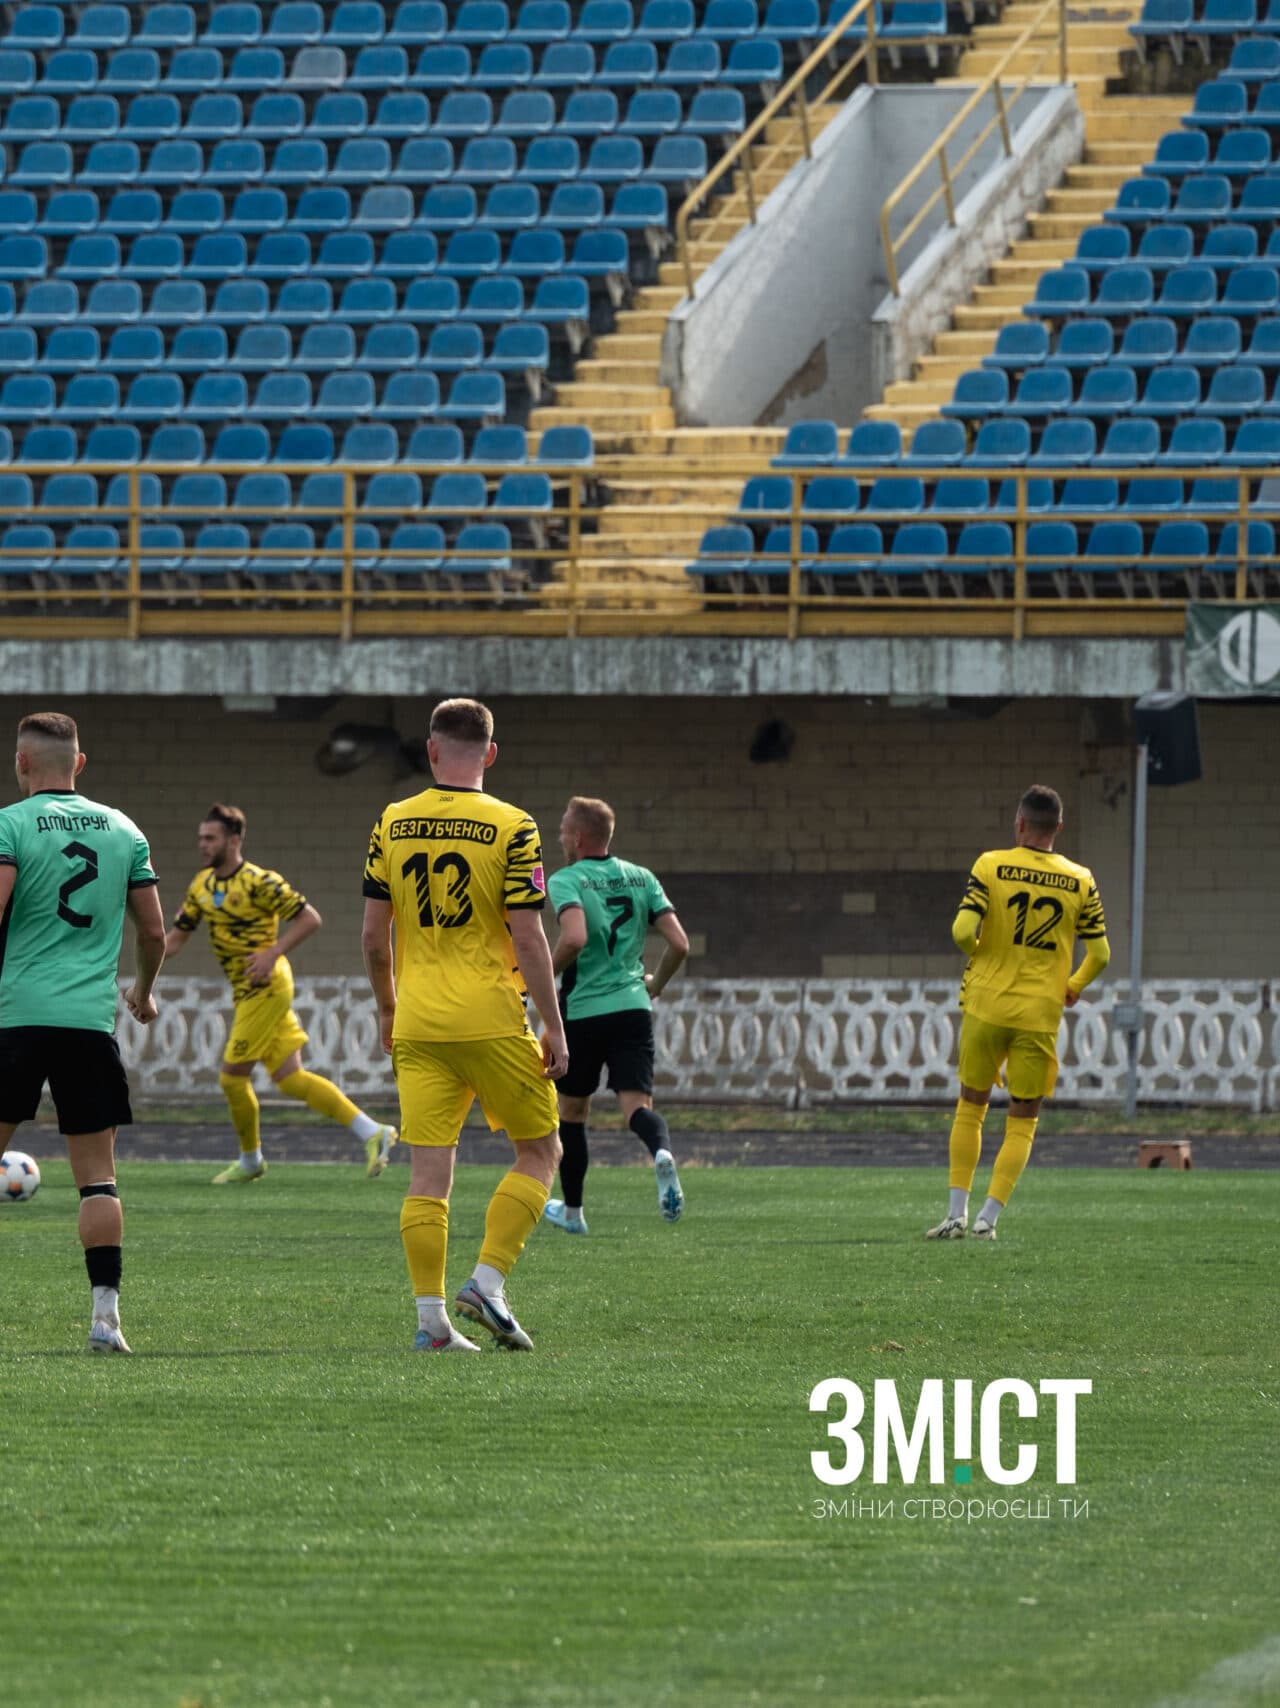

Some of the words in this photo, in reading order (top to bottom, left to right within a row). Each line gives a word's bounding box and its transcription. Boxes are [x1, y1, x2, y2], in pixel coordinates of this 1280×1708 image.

[36, 815, 111, 833] ДМИТРУК
[391, 820, 495, 843] БЕЗГУБЧЕНКО
[57, 840, 99, 929] 2
[402, 851, 473, 929] 13
[1000, 866, 1077, 891] КАРТУШОВ
[605, 895, 634, 957] 7
[1007, 891, 1064, 951] 12
